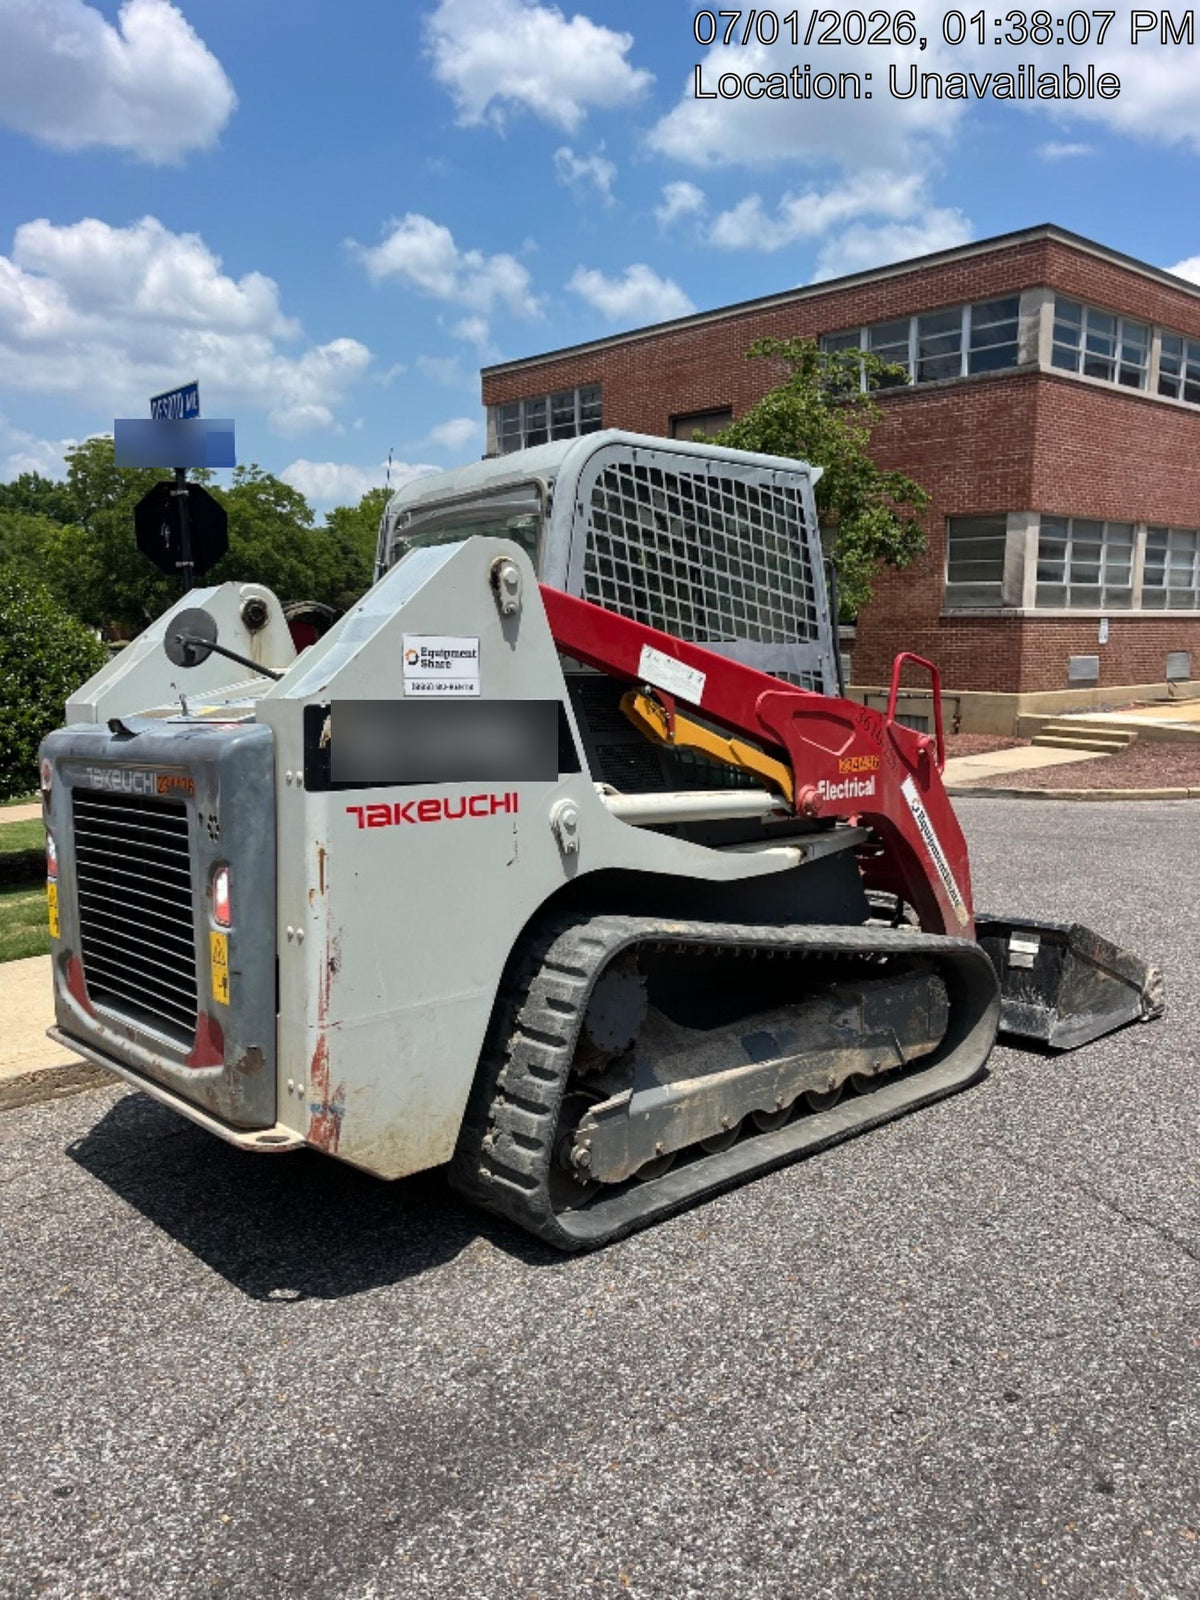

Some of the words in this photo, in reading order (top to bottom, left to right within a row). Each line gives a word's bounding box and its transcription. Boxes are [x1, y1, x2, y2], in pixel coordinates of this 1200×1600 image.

[420, 646, 477, 660] Equipment
[420, 659, 453, 669] Share
[817, 774, 876, 801] Electrical
